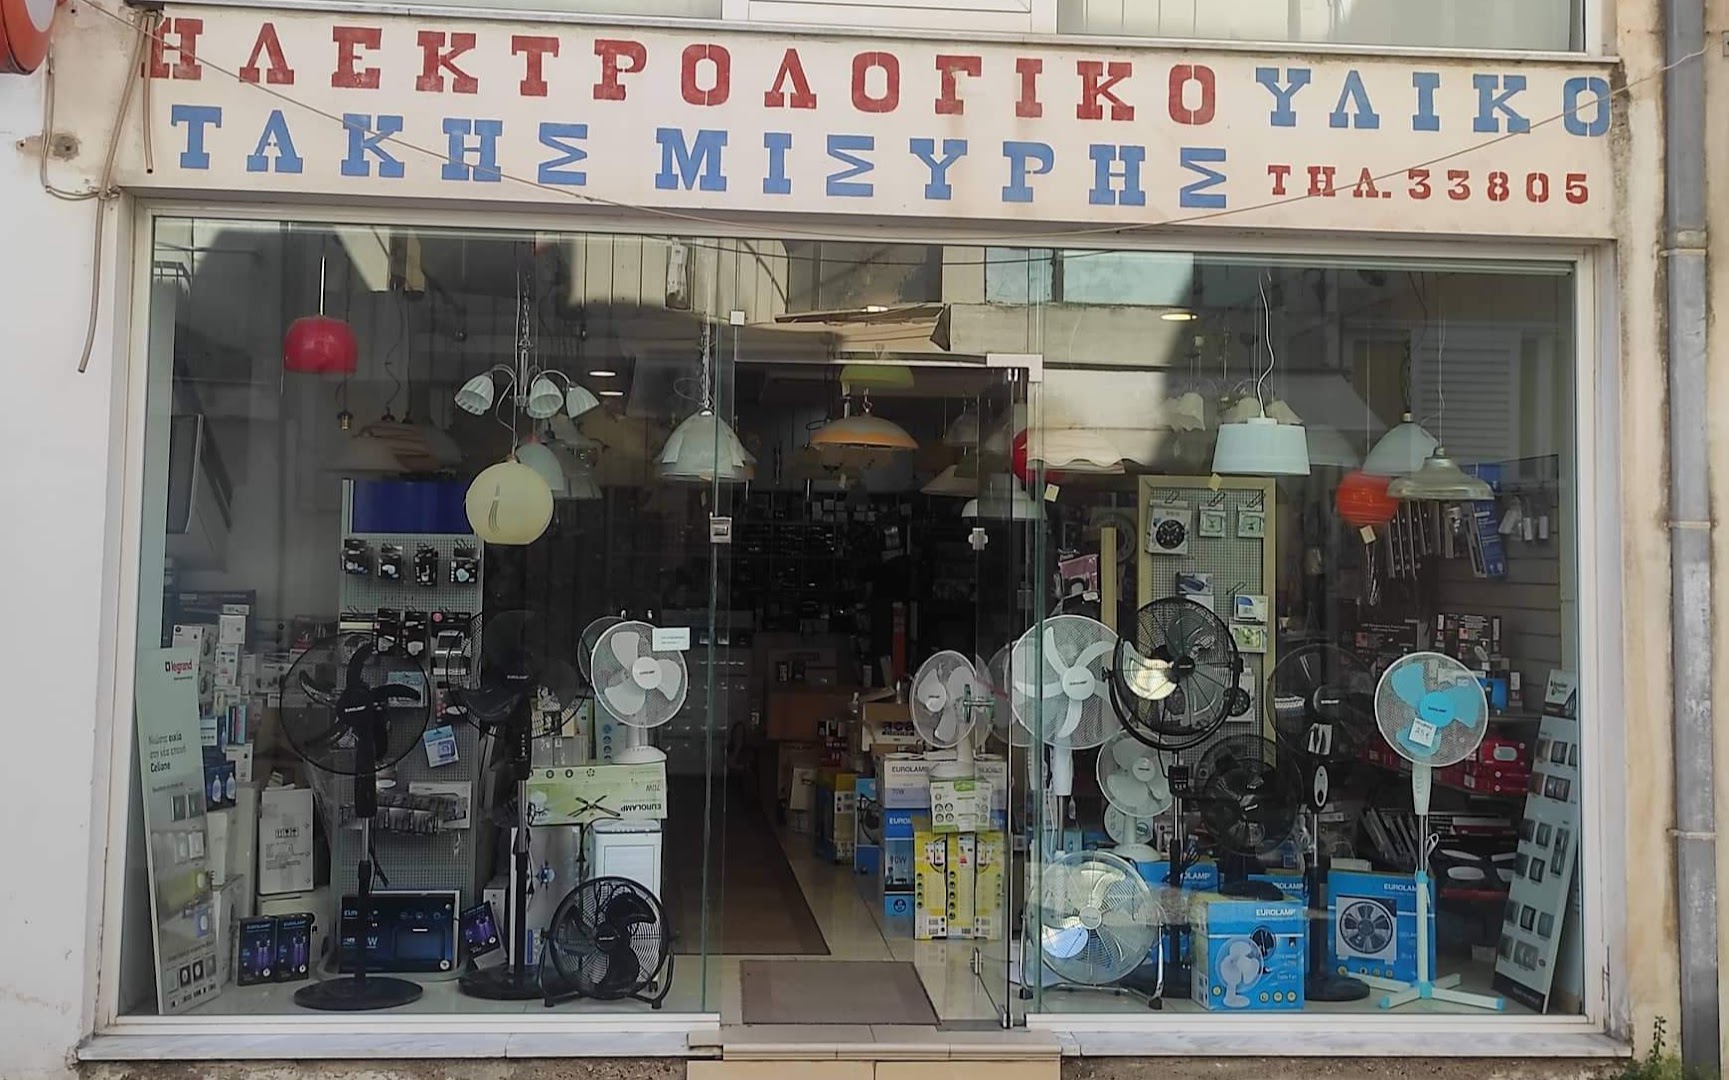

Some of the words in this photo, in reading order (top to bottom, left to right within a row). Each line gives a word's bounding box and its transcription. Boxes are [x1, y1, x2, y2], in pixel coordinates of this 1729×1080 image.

[142, 17, 1216, 125] ΗΛΕΚΤΡΟΛΟΓΙΚΟ
[1256, 67, 1611, 137] ΥΛΙΚΟ
[171, 104, 588, 187] ΤΑΚΗΣ
[656, 127, 1227, 209] ΜΙΣΥΡΗΣ
[1408, 169, 1590, 205] 33805
[171, 660, 192, 674] legrand
[620, 803, 661, 813] EUROLAMP
[1256, 908, 1296, 917] EUROLAMP
